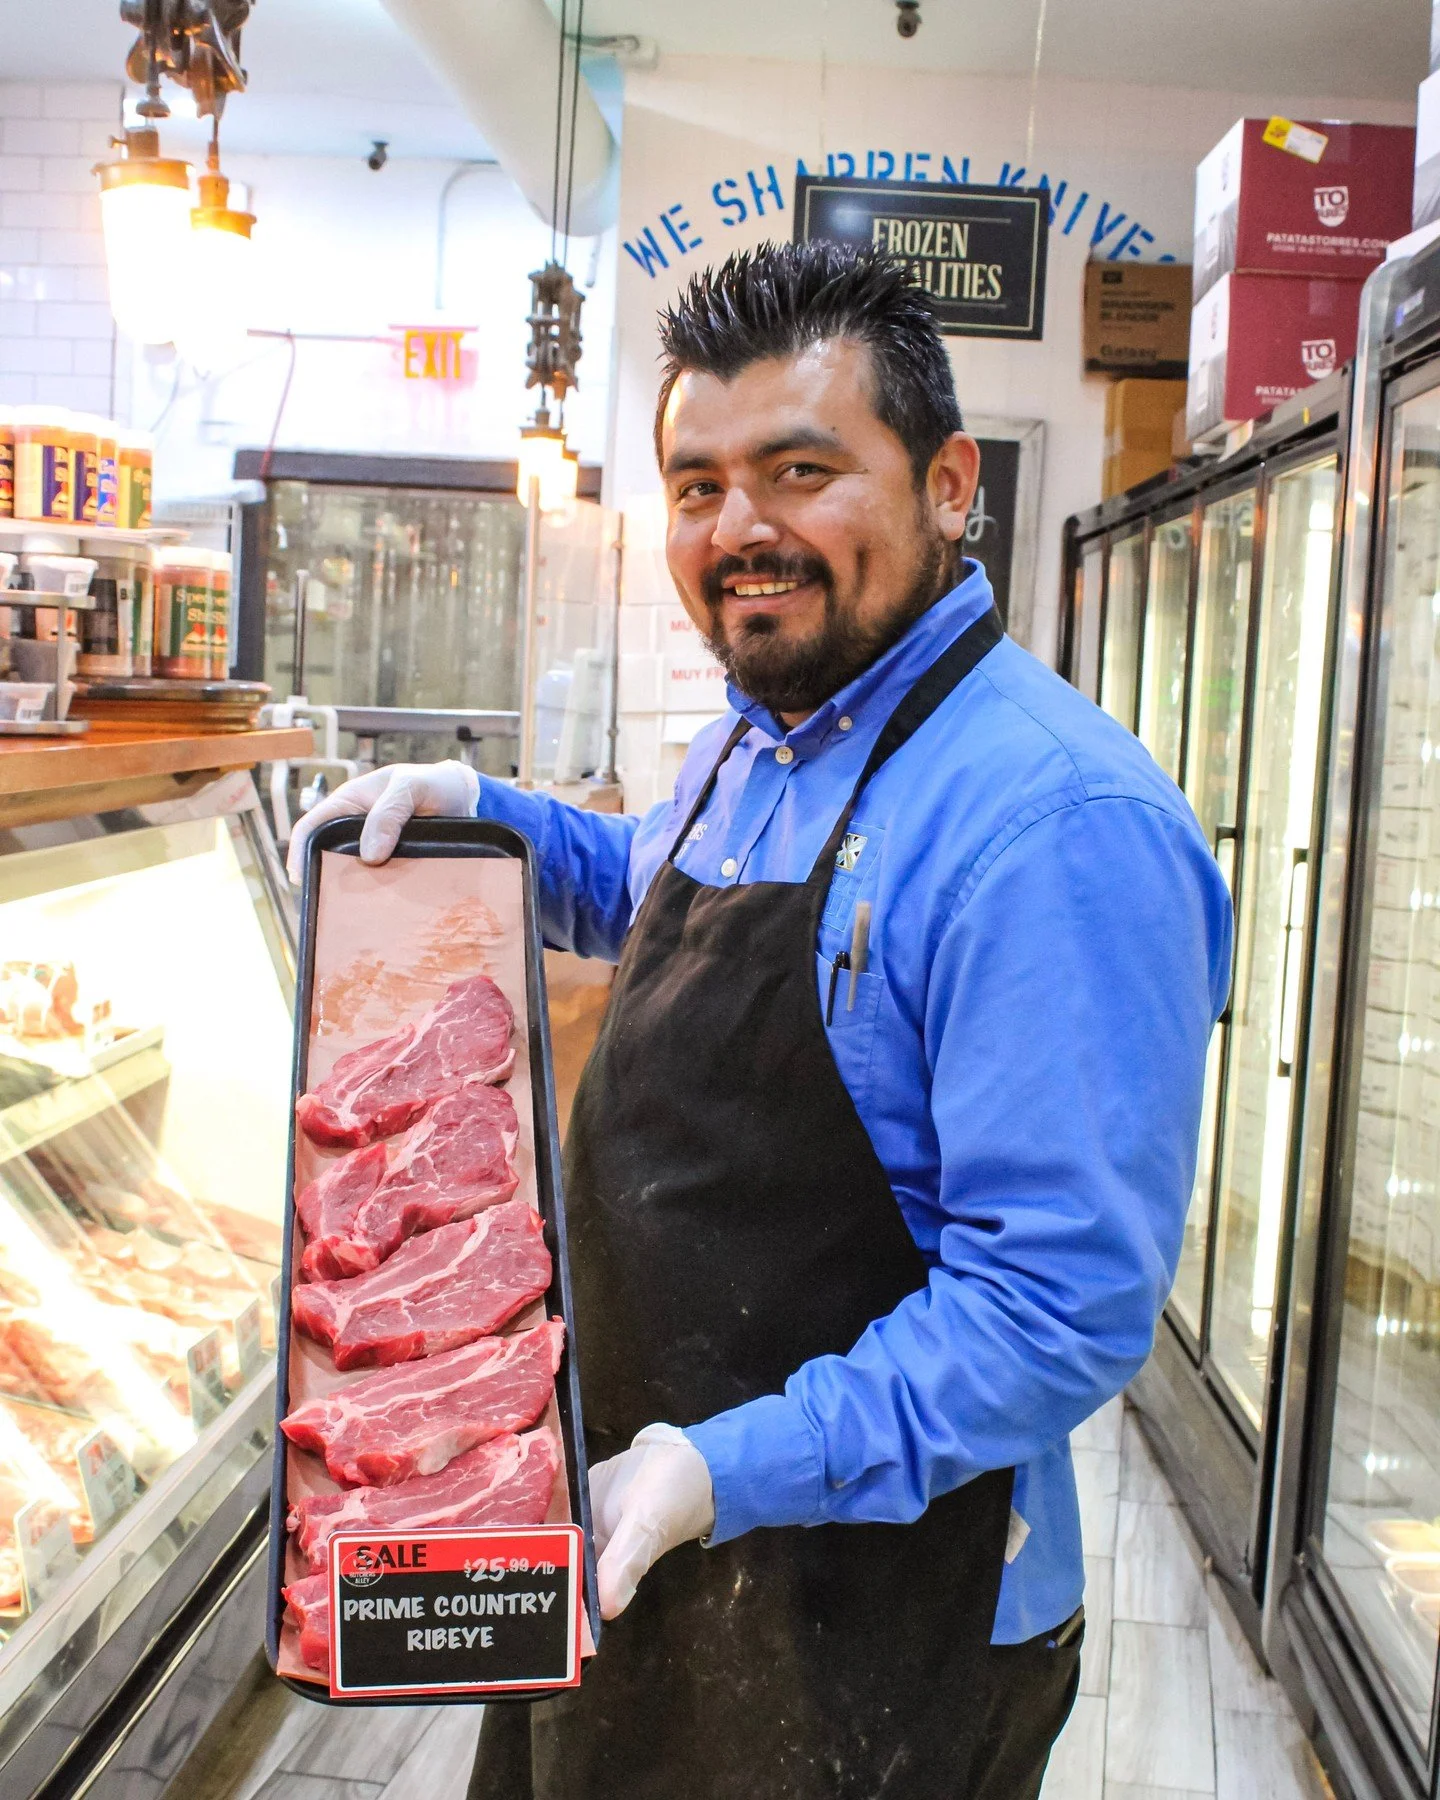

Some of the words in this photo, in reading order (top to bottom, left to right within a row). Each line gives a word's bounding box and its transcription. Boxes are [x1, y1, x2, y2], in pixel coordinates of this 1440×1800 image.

[623, 203, 702, 279] WE
[998, 162, 1176, 262] KNIVE
[872, 218, 969, 259] FROZEN
[404, 331, 464, 379] EXIT
[670, 620, 692, 632] MU
[672, 670, 700, 681] MUY
[355, 1543, 427, 1570] SALE
[464, 1557, 528, 1582] $25.99
[343, 1597, 425, 1621] PRIME
[434, 1592, 556, 1617] COUNTRY
[407, 1626, 494, 1651] RIBEYE
